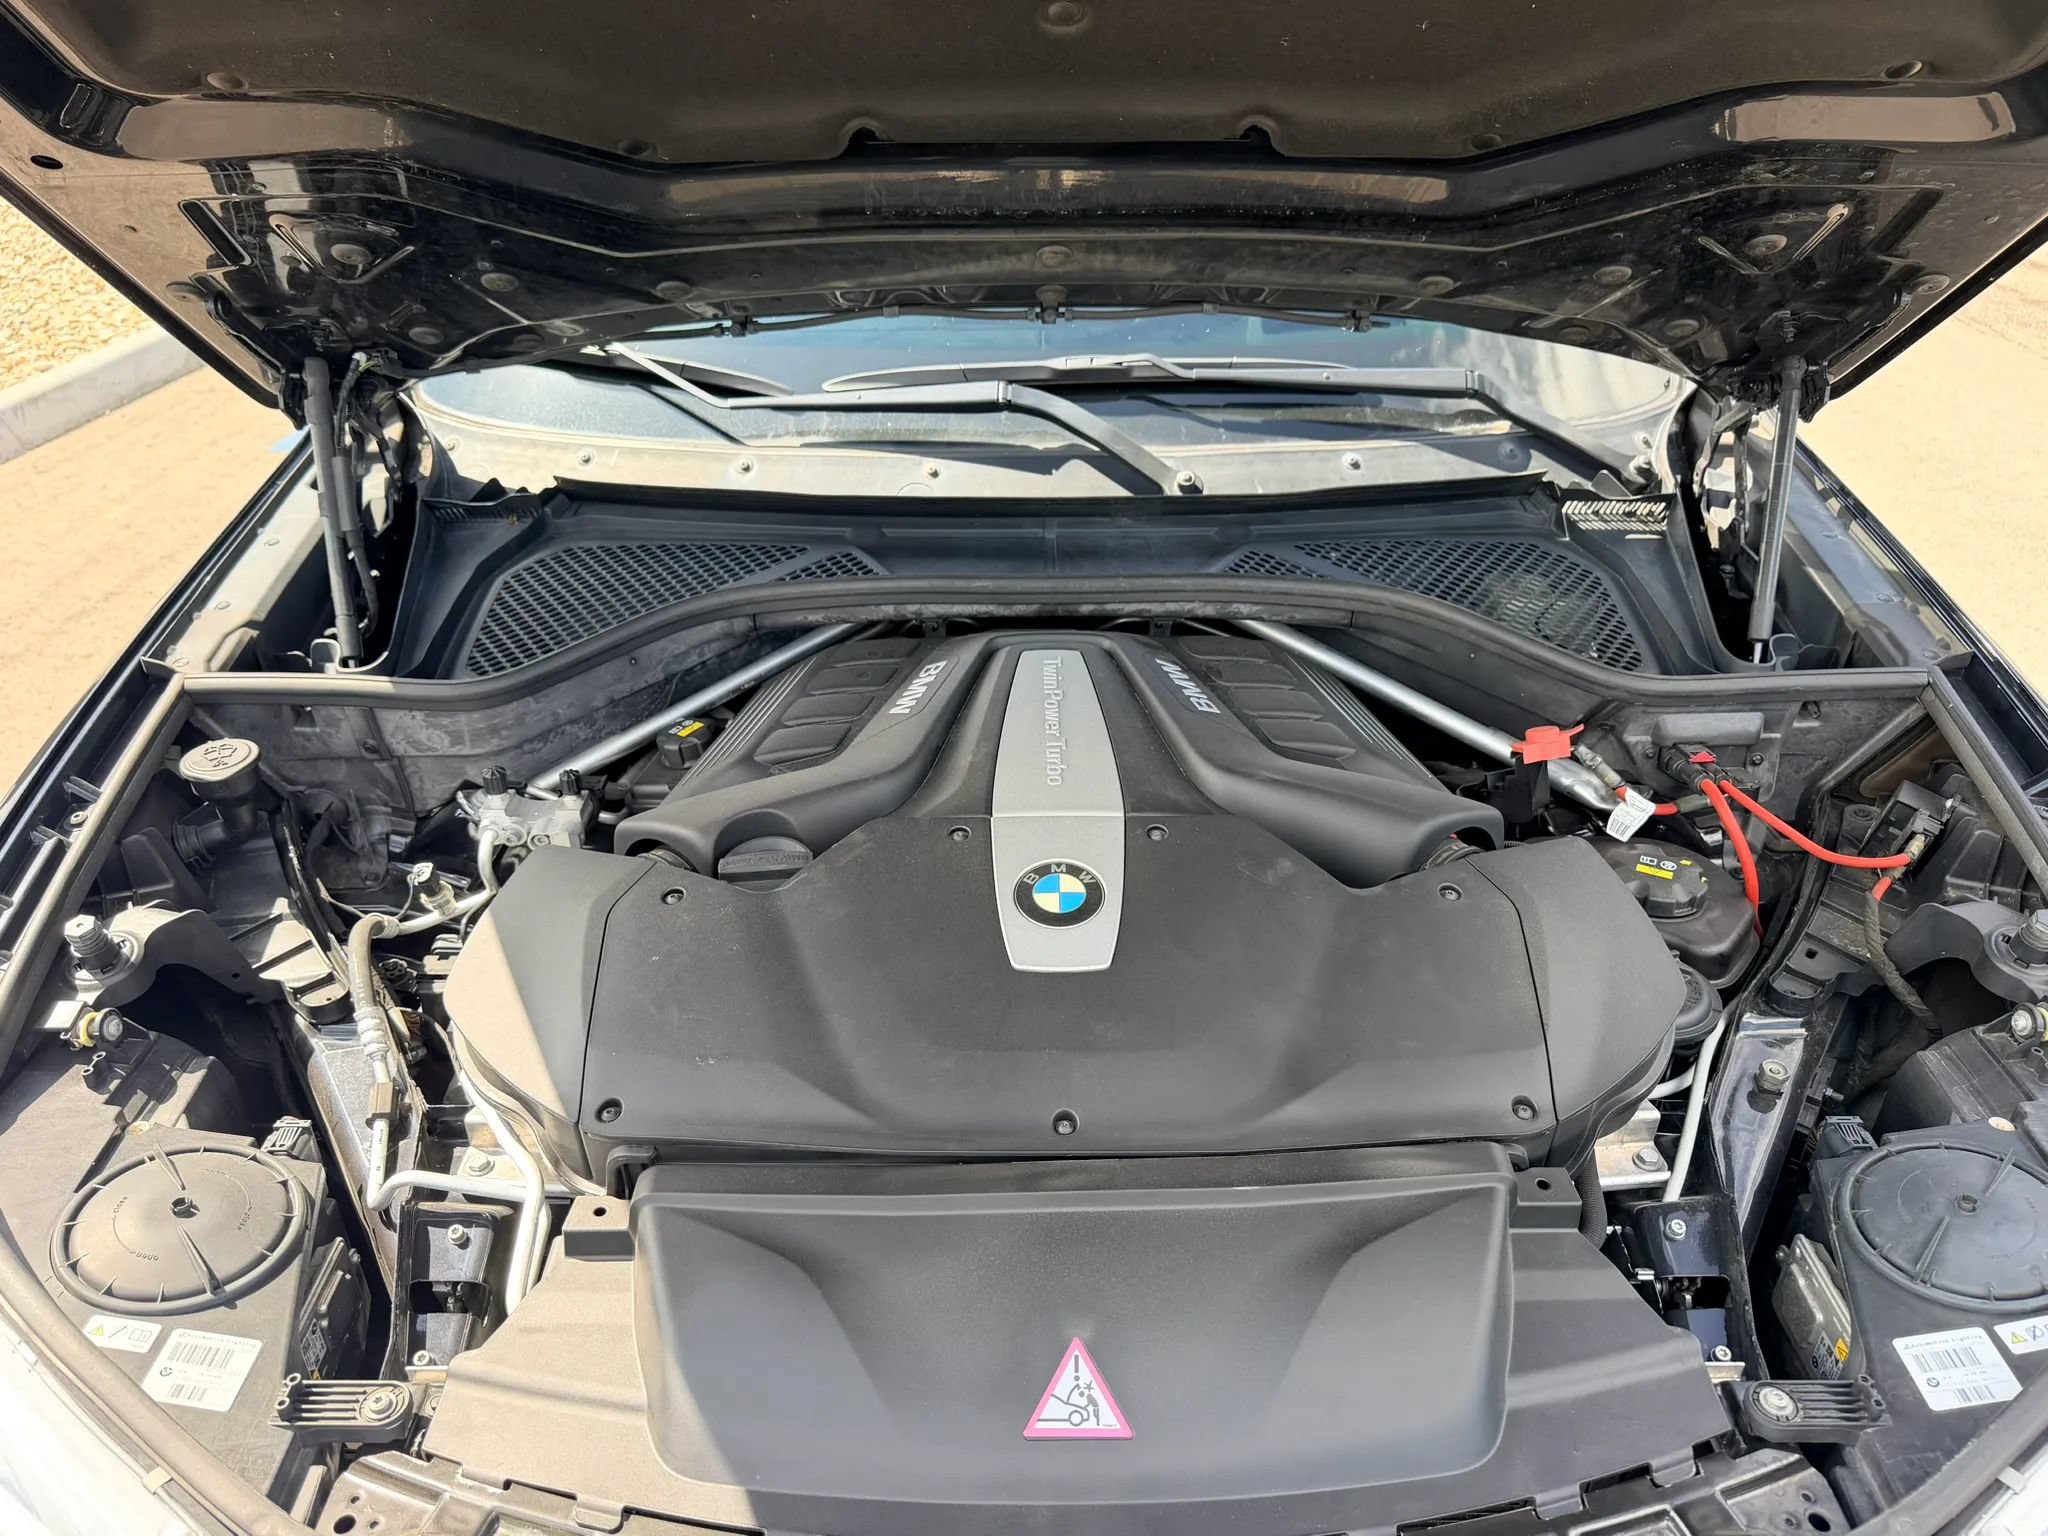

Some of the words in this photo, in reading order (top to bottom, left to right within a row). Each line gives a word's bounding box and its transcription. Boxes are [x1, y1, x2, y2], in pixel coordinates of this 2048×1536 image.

[888, 659, 948, 715] BMW
[1042, 656, 1064, 736] TwinPower
[1154, 658, 1221, 715] BMW
[1046, 738, 1065, 786] Turbo
[1022, 863, 1097, 885] BMW
